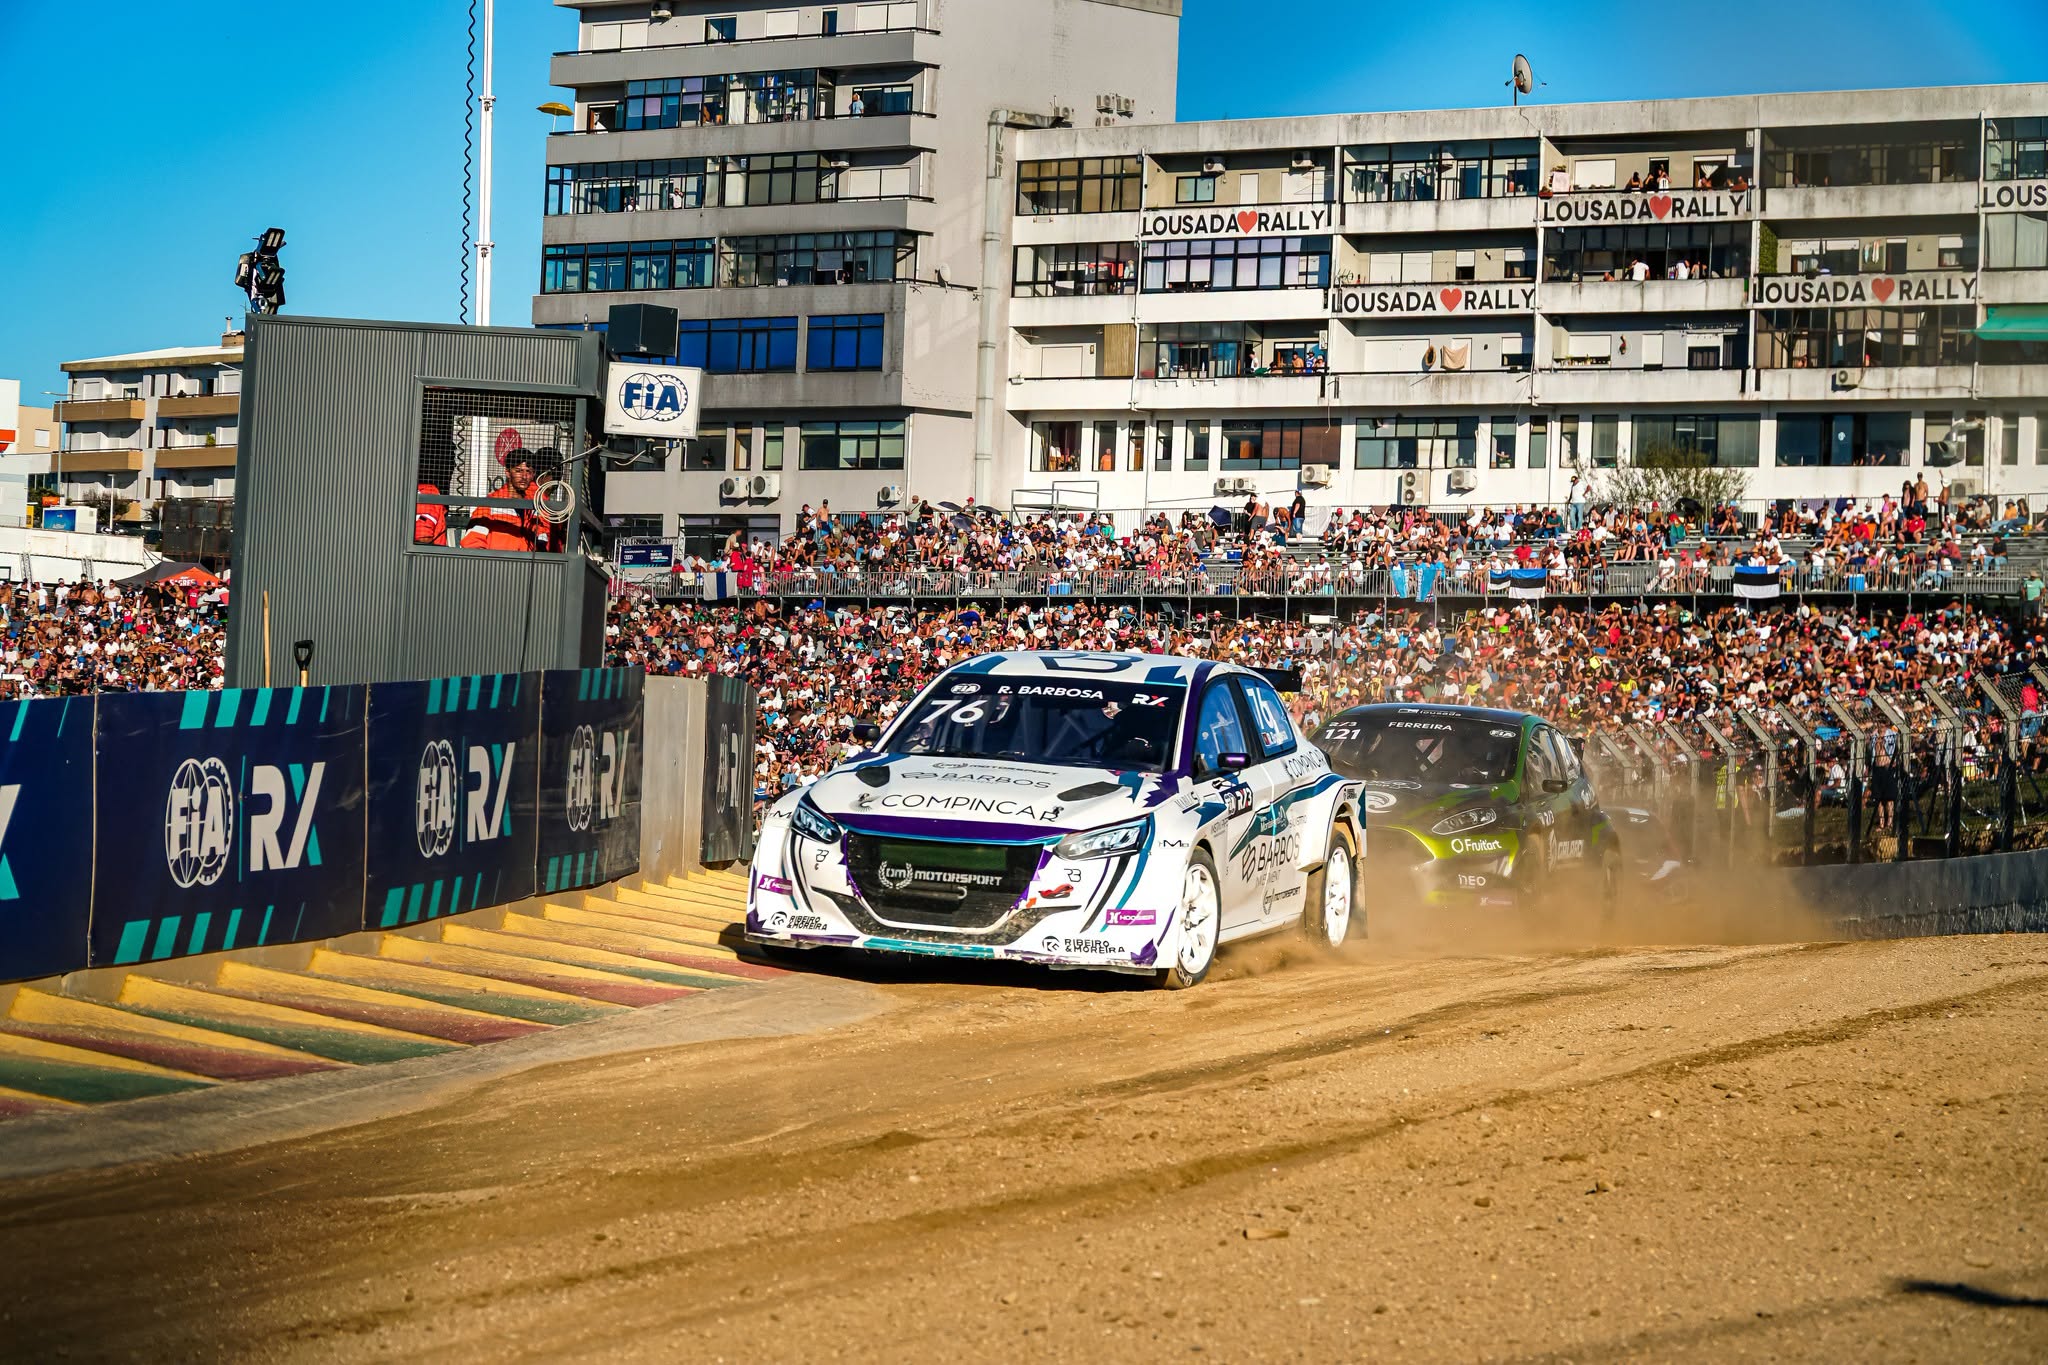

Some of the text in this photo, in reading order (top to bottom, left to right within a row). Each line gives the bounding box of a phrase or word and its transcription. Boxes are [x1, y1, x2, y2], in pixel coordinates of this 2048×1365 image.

[1543, 194, 1745, 222] LOUSADA RALLY
[1142, 209, 1325, 236] LOUSADA RALLY
[1331, 287, 1536, 314] LOUSADA RALLY
[1752, 276, 1977, 304] LOUSADA RALLY
[951, 683, 1169, 708] FIA R. BARBOSA RX
[919, 699, 984, 724] 76
[1324, 728, 1362, 740] 121
[1388, 720, 1453, 731] FERREIRA
[466, 741, 516, 843] RX
[941, 773, 1052, 789] BARBOS
[250, 761, 326, 872] RX
[881, 794, 1061, 823] COMPINCAR
[914, 869, 1003, 887] MOTORSPORT
[789, 914, 822, 924] RIBEIRO
[1064, 938, 1110, 948] RIBEIRO
